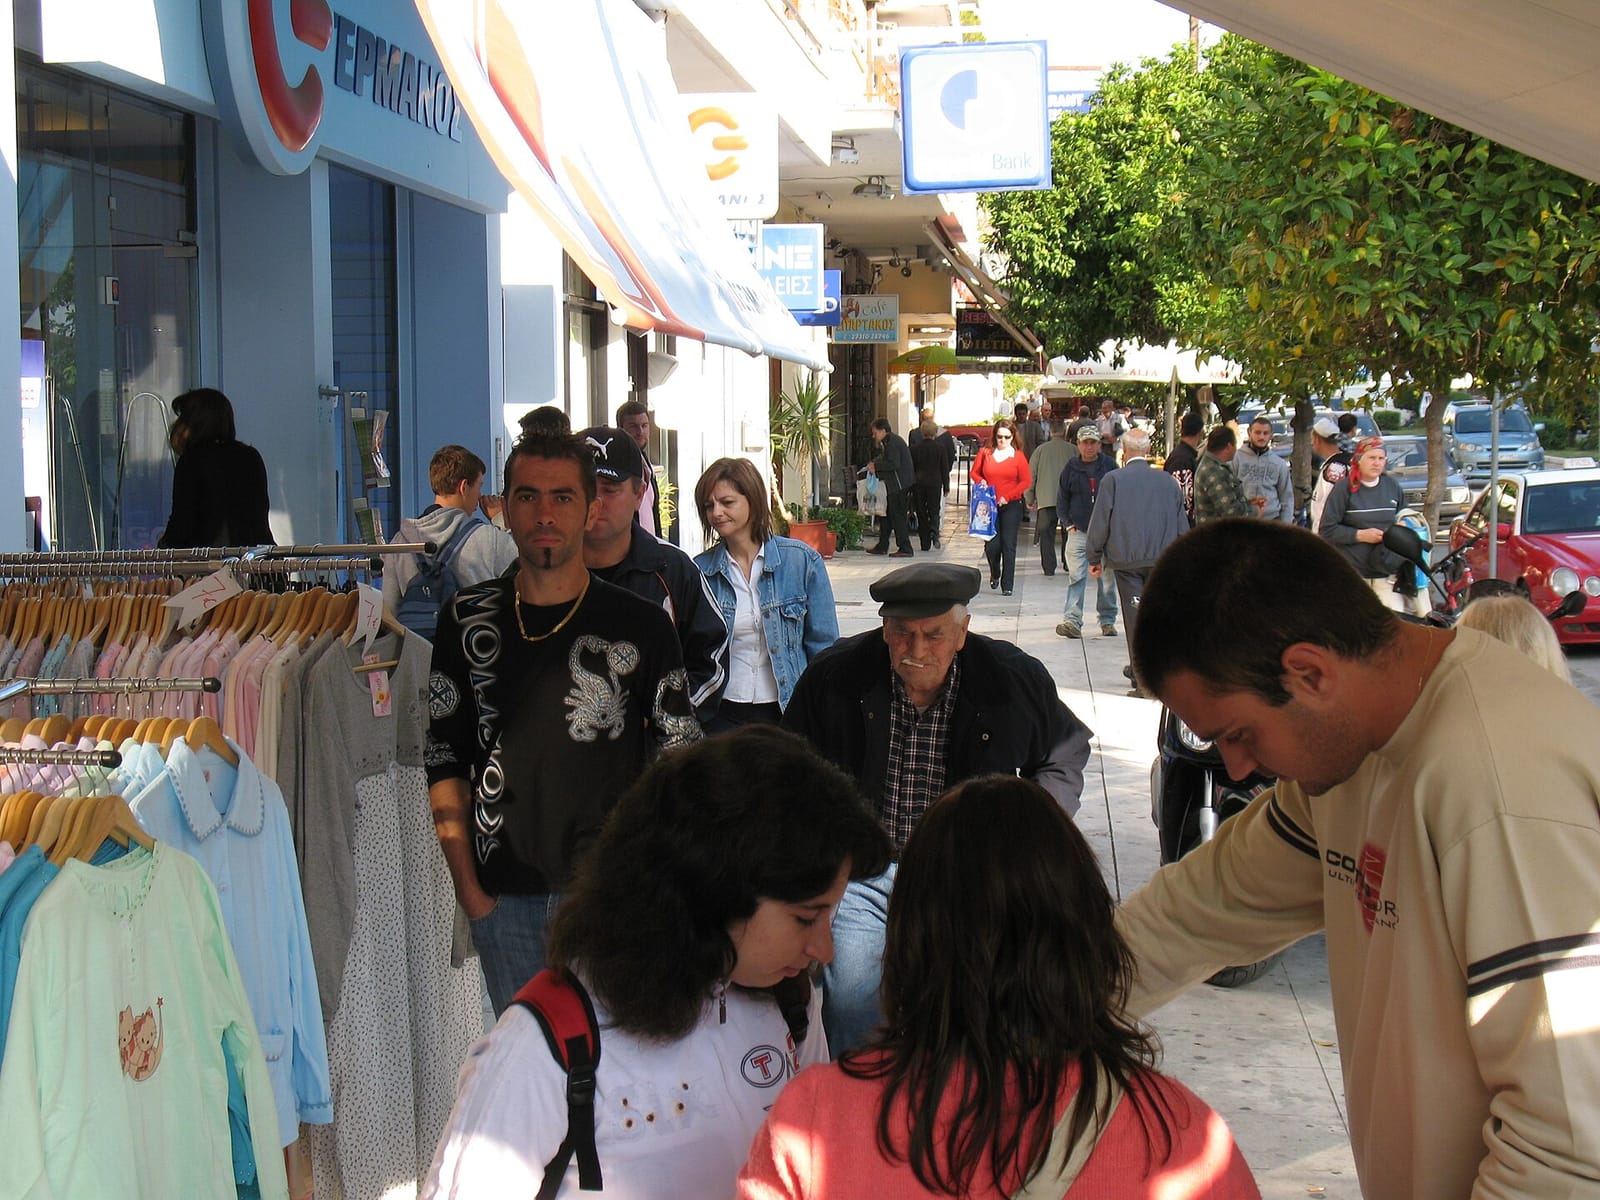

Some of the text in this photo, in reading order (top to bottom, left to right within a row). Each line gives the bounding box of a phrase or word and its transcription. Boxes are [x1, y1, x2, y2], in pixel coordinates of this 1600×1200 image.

[334, 12, 462, 143] ΕΡΜΑΝΟΣ
[992, 151, 1033, 170] Bank
[1064, 367, 1094, 376] ALFA
